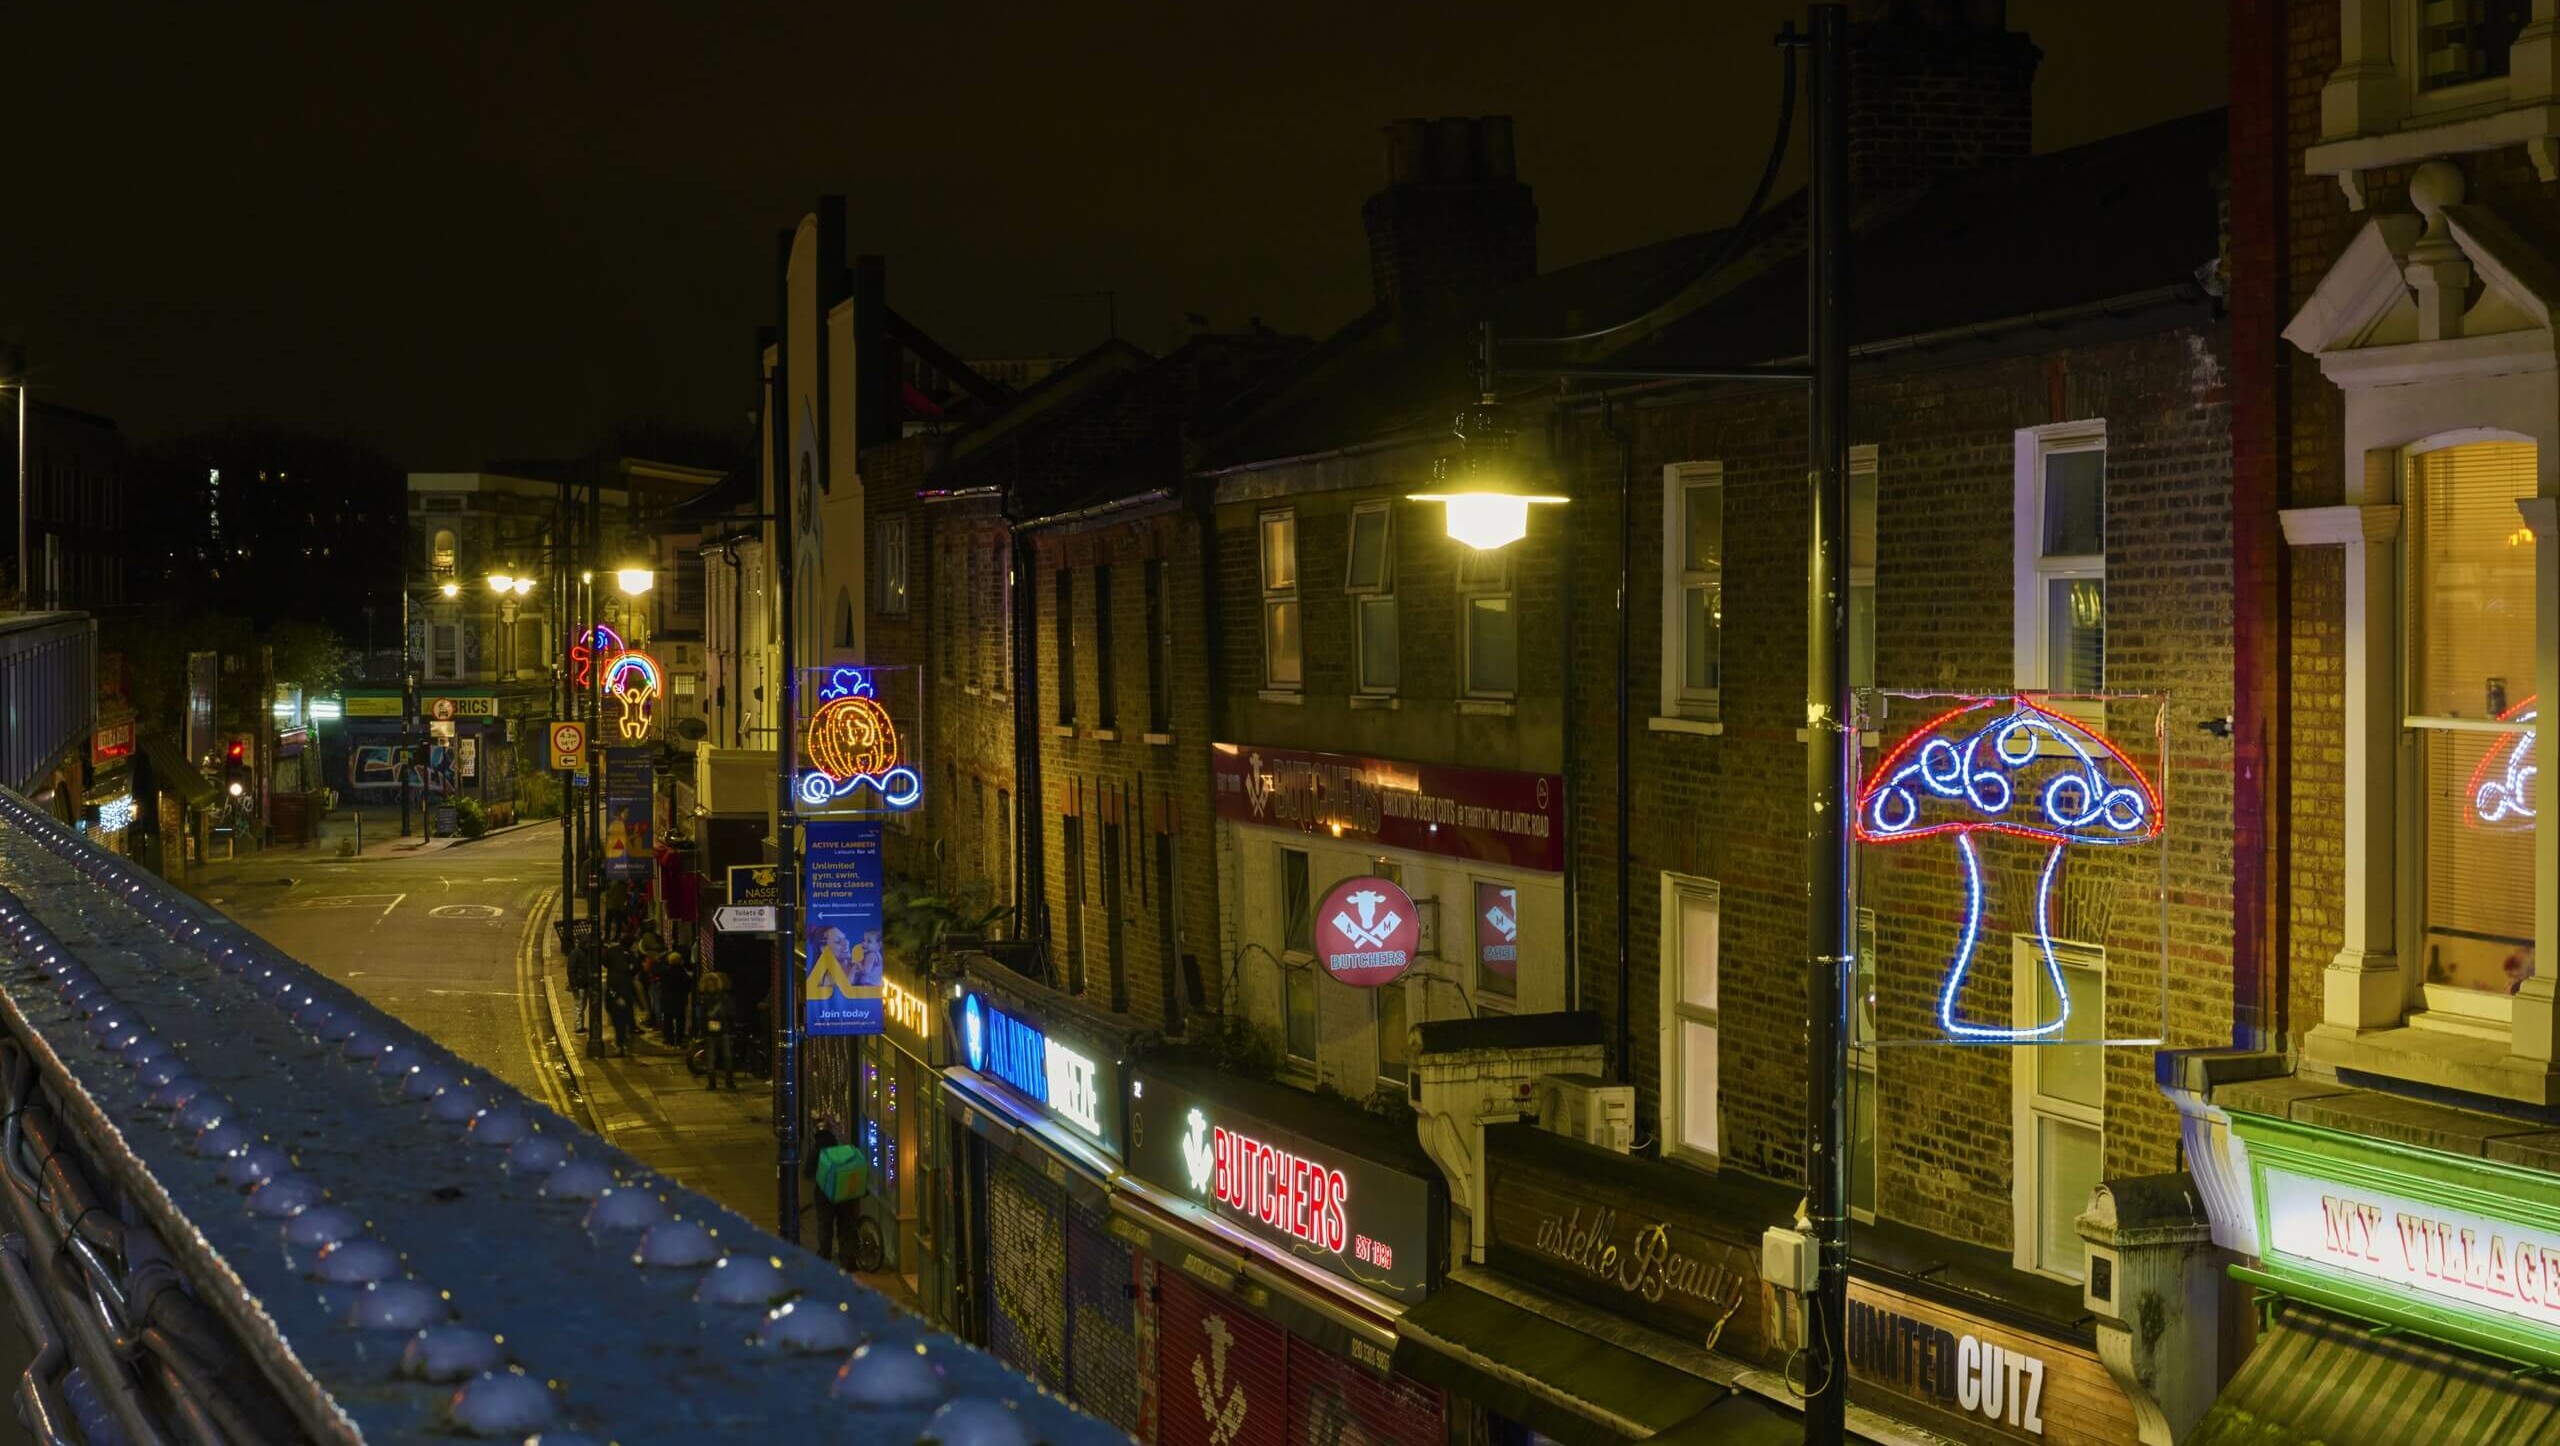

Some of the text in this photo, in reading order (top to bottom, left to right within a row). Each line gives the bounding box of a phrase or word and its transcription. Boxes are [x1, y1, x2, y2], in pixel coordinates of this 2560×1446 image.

[1273, 758, 1381, 834] BUTCHERS
[1419, 795, 1436, 823] BEST
[1436, 798, 1455, 825] CUTS
[1464, 806, 1486, 829] THIRTY
[1486, 808, 1500, 832] TWO
[1501, 810, 1531, 835] ATLANTIC
[1531, 814, 1550, 839] ROAD
[841, 841, 876, 849] LAMBETH
[812, 862, 855, 870] Unlimited
[745, 887, 779, 898] NASSE
[812, 880, 874, 888] fitness classes
[812, 890, 829, 898] and
[1346, 920, 1392, 935] A M
[1330, 950, 1406, 970] BUTCHERS
[820, 1010, 869, 1019] Join today
[1213, 1124, 1347, 1254] BUTCHERS
[1355, 1234, 1372, 1262] EST
[2321, 1194, 2560, 1311] MY VILLAGE
[1618, 1222, 1743, 1351] Beauty
[1847, 1298, 2043, 1435] UNITED CUTZ
